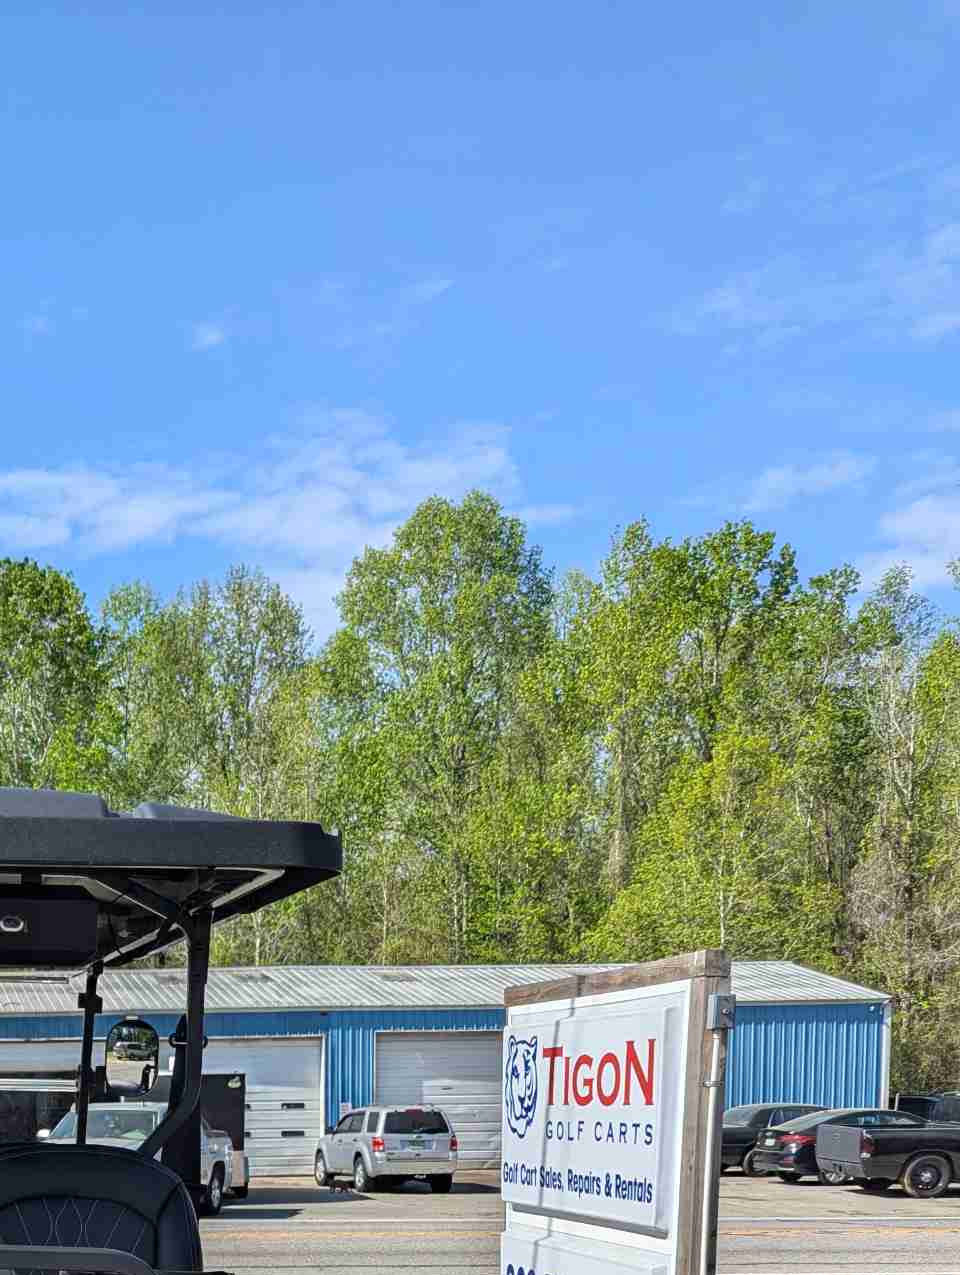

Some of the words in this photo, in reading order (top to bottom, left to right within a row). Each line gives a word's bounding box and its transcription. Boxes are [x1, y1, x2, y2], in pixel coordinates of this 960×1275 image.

[545, 1120, 585, 1141] GOLF
[594, 1121, 654, 1146] CARTS
[503, 1162, 519, 1184] Golf
[520, 1163, 538, 1187] Cart
[539, 1166, 564, 1192] Sales,
[567, 1168, 602, 1198] Repairs
[604, 1172, 613, 1198] &
[615, 1174, 654, 1203] Rentals
